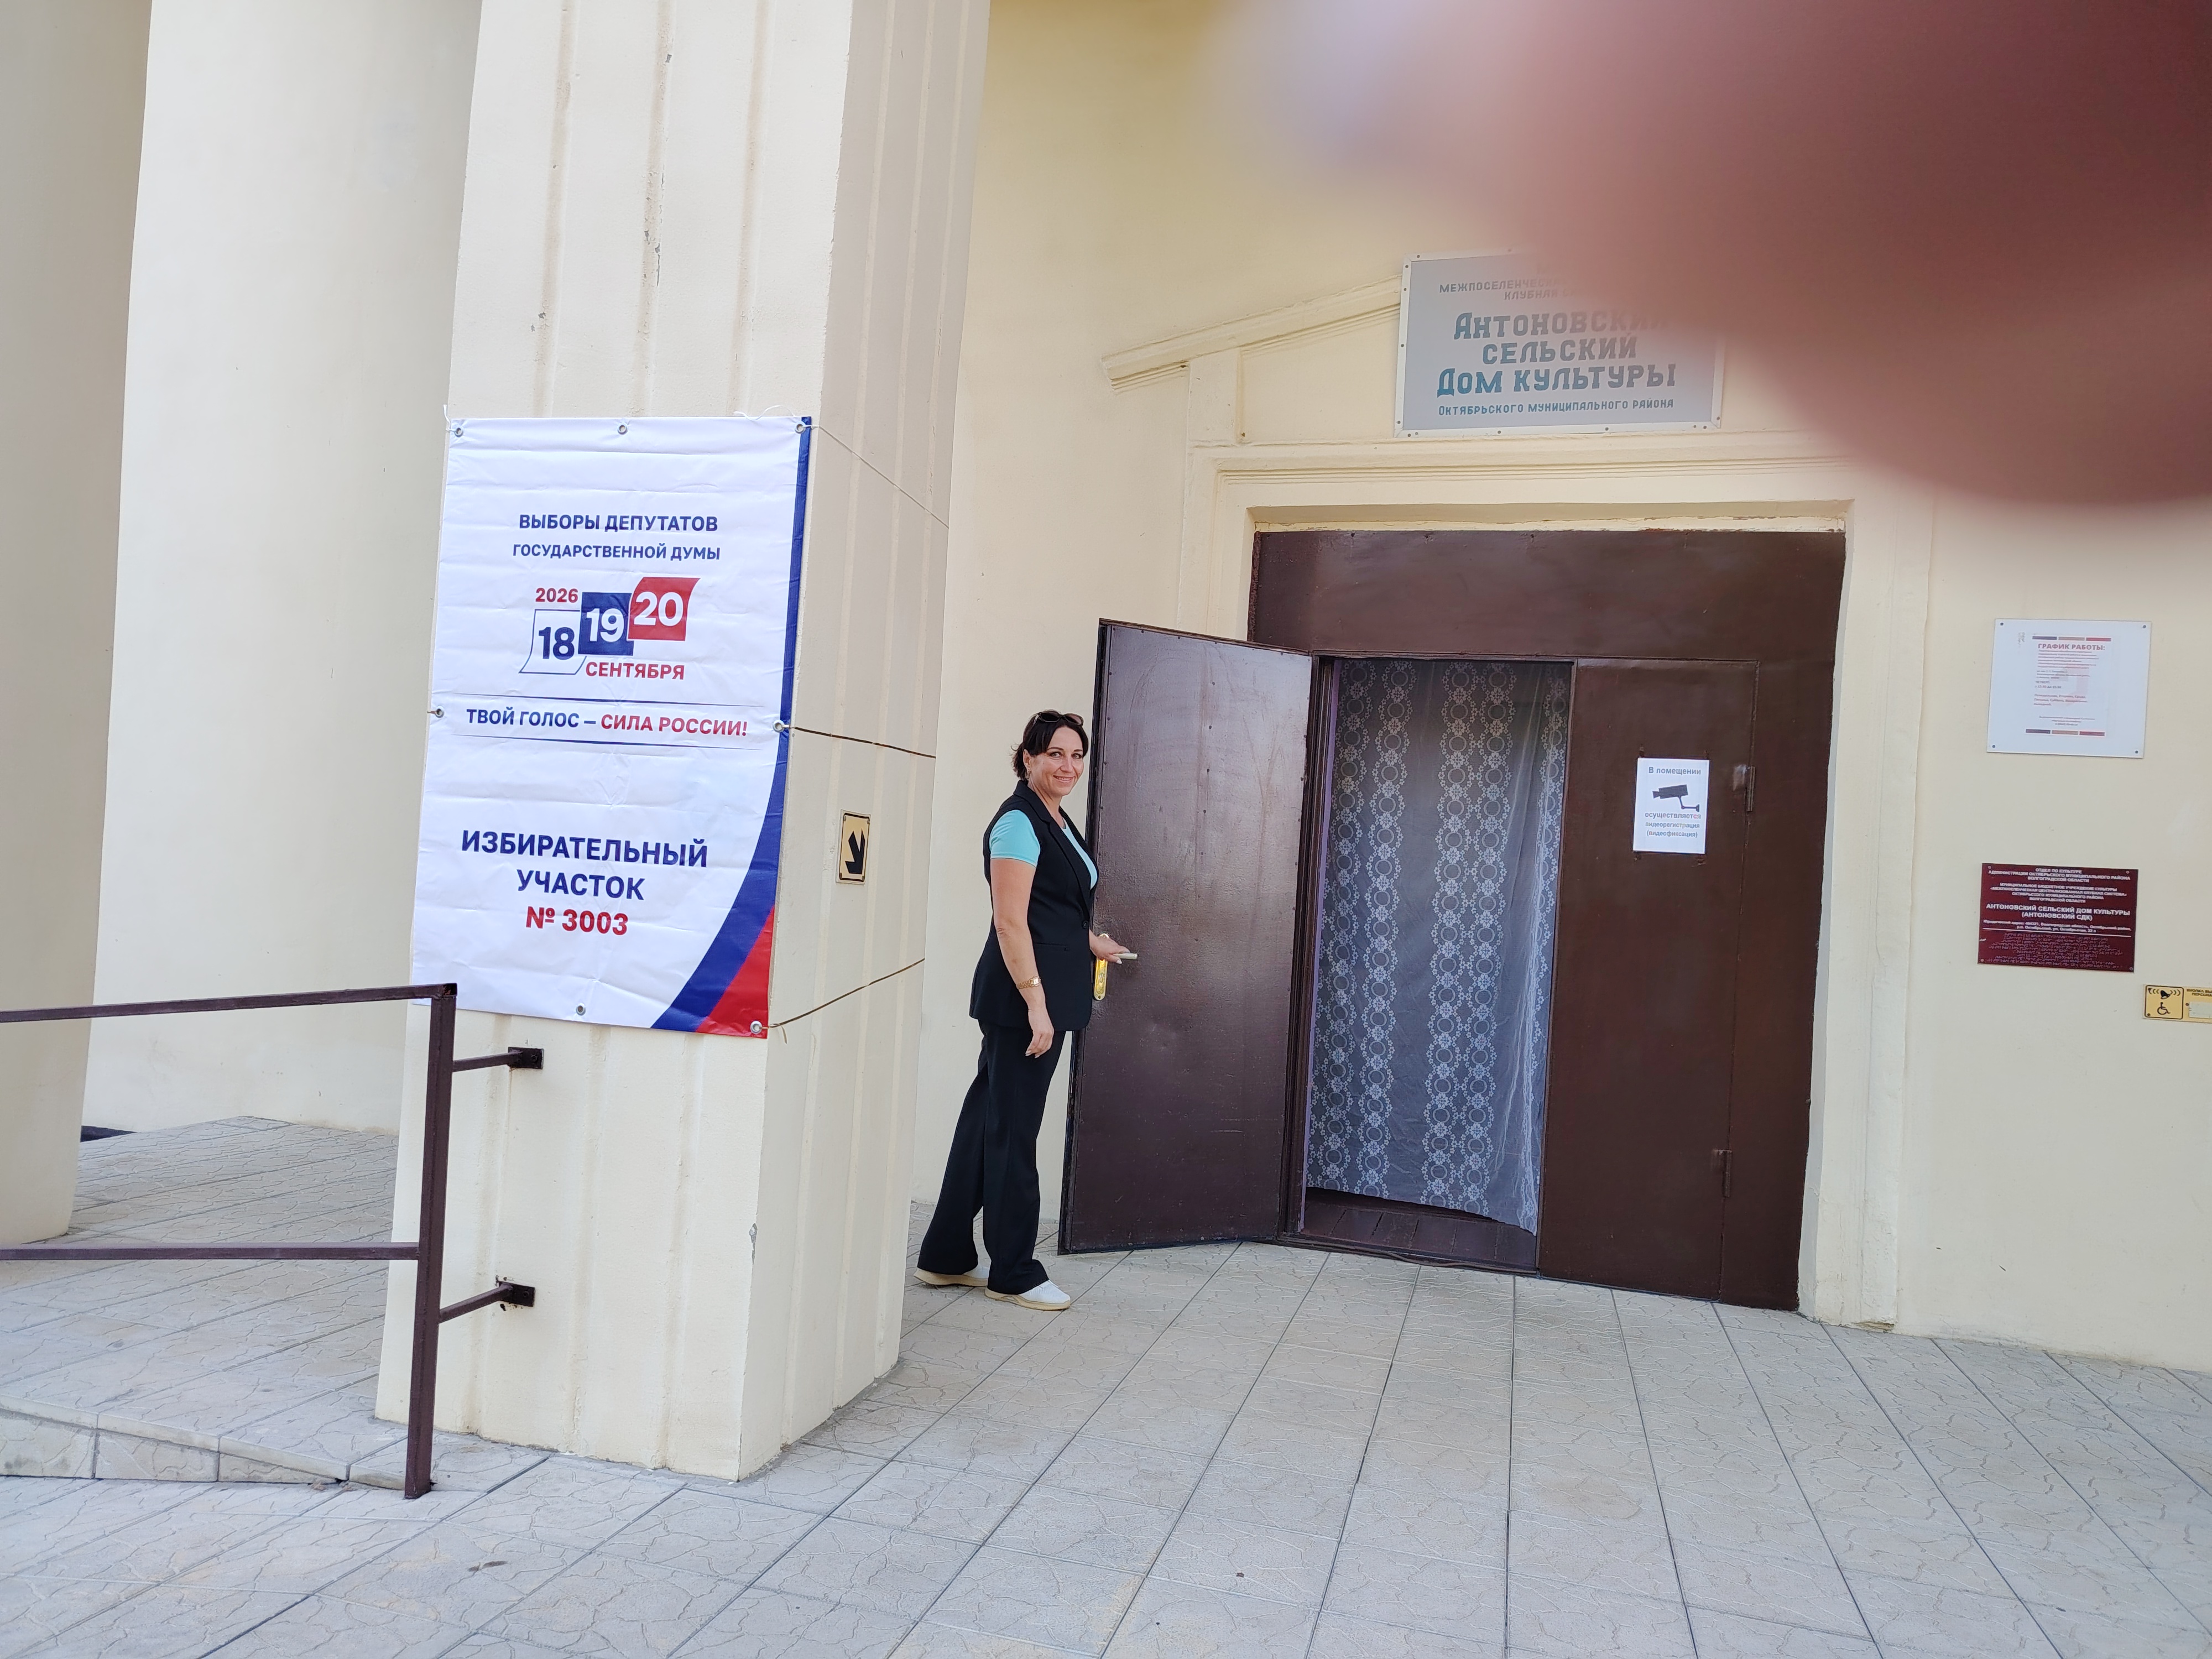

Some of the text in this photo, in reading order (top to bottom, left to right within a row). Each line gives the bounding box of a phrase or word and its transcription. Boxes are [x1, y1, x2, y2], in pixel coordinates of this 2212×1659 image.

[1483, 332, 1637, 365] СЕЛЬСКИЙ
[1437, 363, 1676, 398] ДОМ КУЛЬТУРЫ
[1528, 400, 1629, 413] МУНИЦИПАЛЬНОГО
[1632, 398, 1674, 410] РАЙОНА
[519, 514, 718, 533] ВЫБОРЫ ДЕПУТАТОВ
[513, 542, 721, 561] ГОСУДАРСТВЕННОЙ ДУМЫ
[535, 588, 578, 603] 2026
[539, 592, 684, 660] 18 19 20
[586, 662, 685, 680] СЕНТЯБРЯ
[466, 707, 515, 726] ТВОЙ
[519, 711, 580, 728] ГОЛОС
[601, 714, 654, 731] СИЛА
[659, 719, 747, 736] РОССИИ!
[1646, 830, 1698, 838] (видеофиксация)
[461, 830, 708, 868] ИЗБИРАТЕЛЬНЫЙ
[517, 869, 645, 900] УЧАСТОК
[1986, 903, 2037, 911] АНТОНОВСКИЙ
[2022, 911, 2075, 920] (АНТОНОВСКИЙ
[525, 906, 629, 936] № 3003
